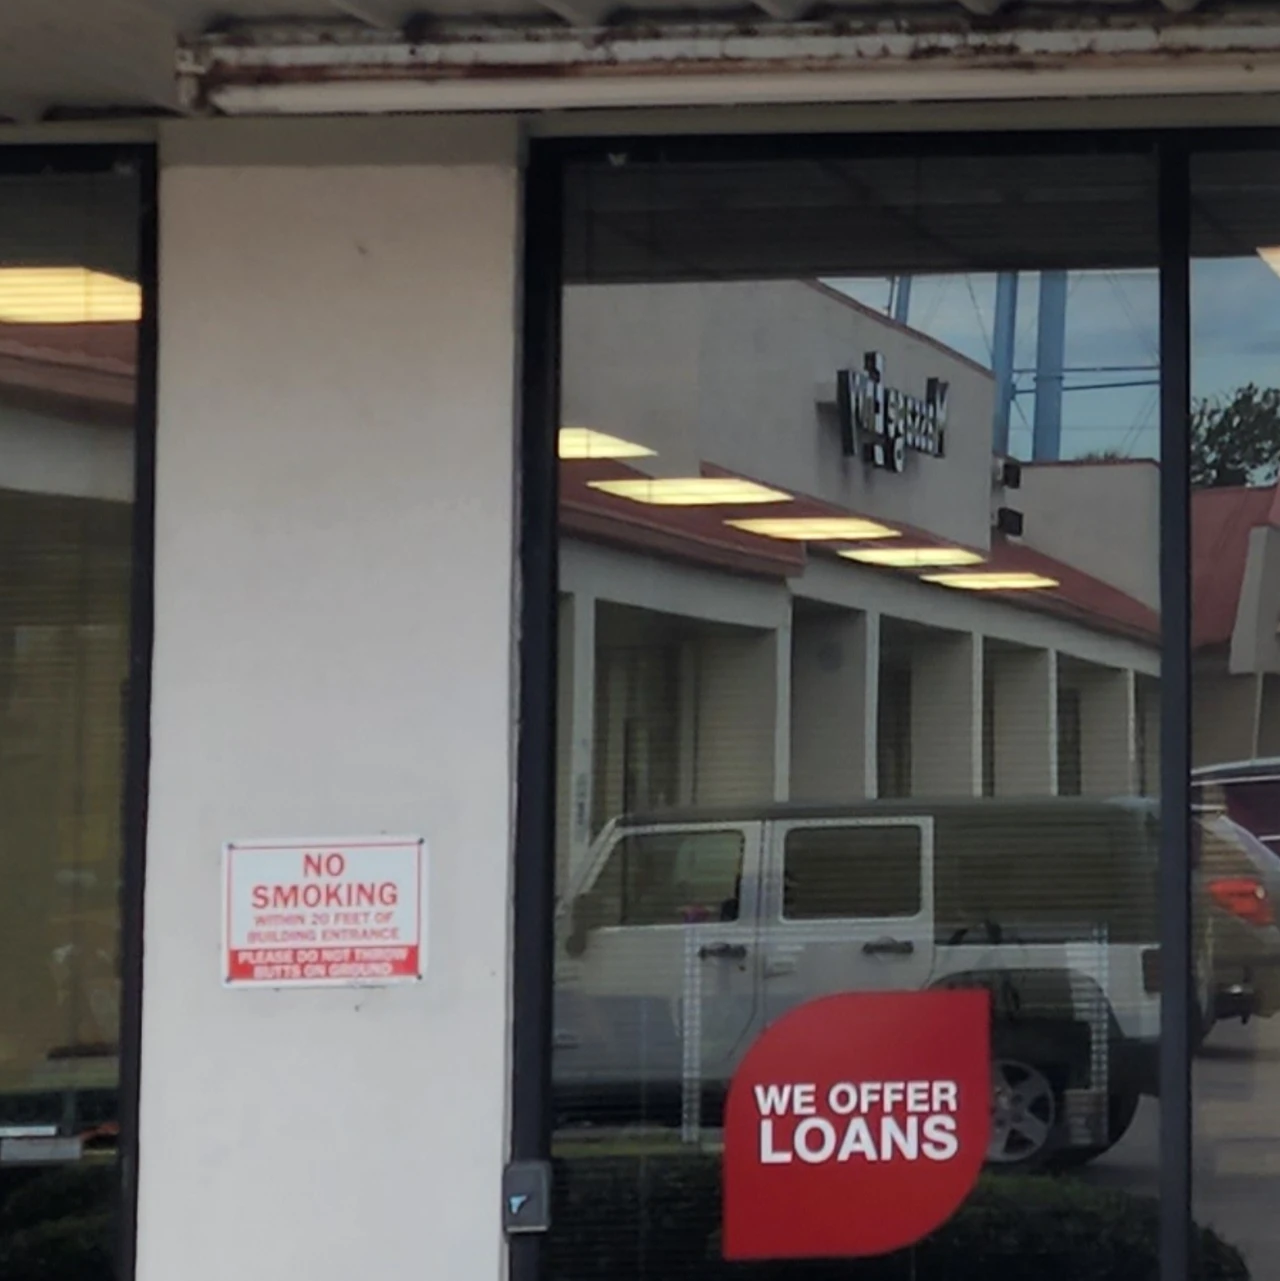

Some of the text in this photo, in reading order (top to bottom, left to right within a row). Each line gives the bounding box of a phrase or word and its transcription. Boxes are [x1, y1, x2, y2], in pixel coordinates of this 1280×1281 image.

[303, 853, 345, 877] NO
[252, 882, 398, 909] SMOKING
[254, 912, 393, 926] WITHIN 20 FEET OF
[247, 927, 400, 942] BUILDING ENTRANCE
[754, 1081, 957, 1115] WE OFFER
[760, 1115, 958, 1163] LOANS
